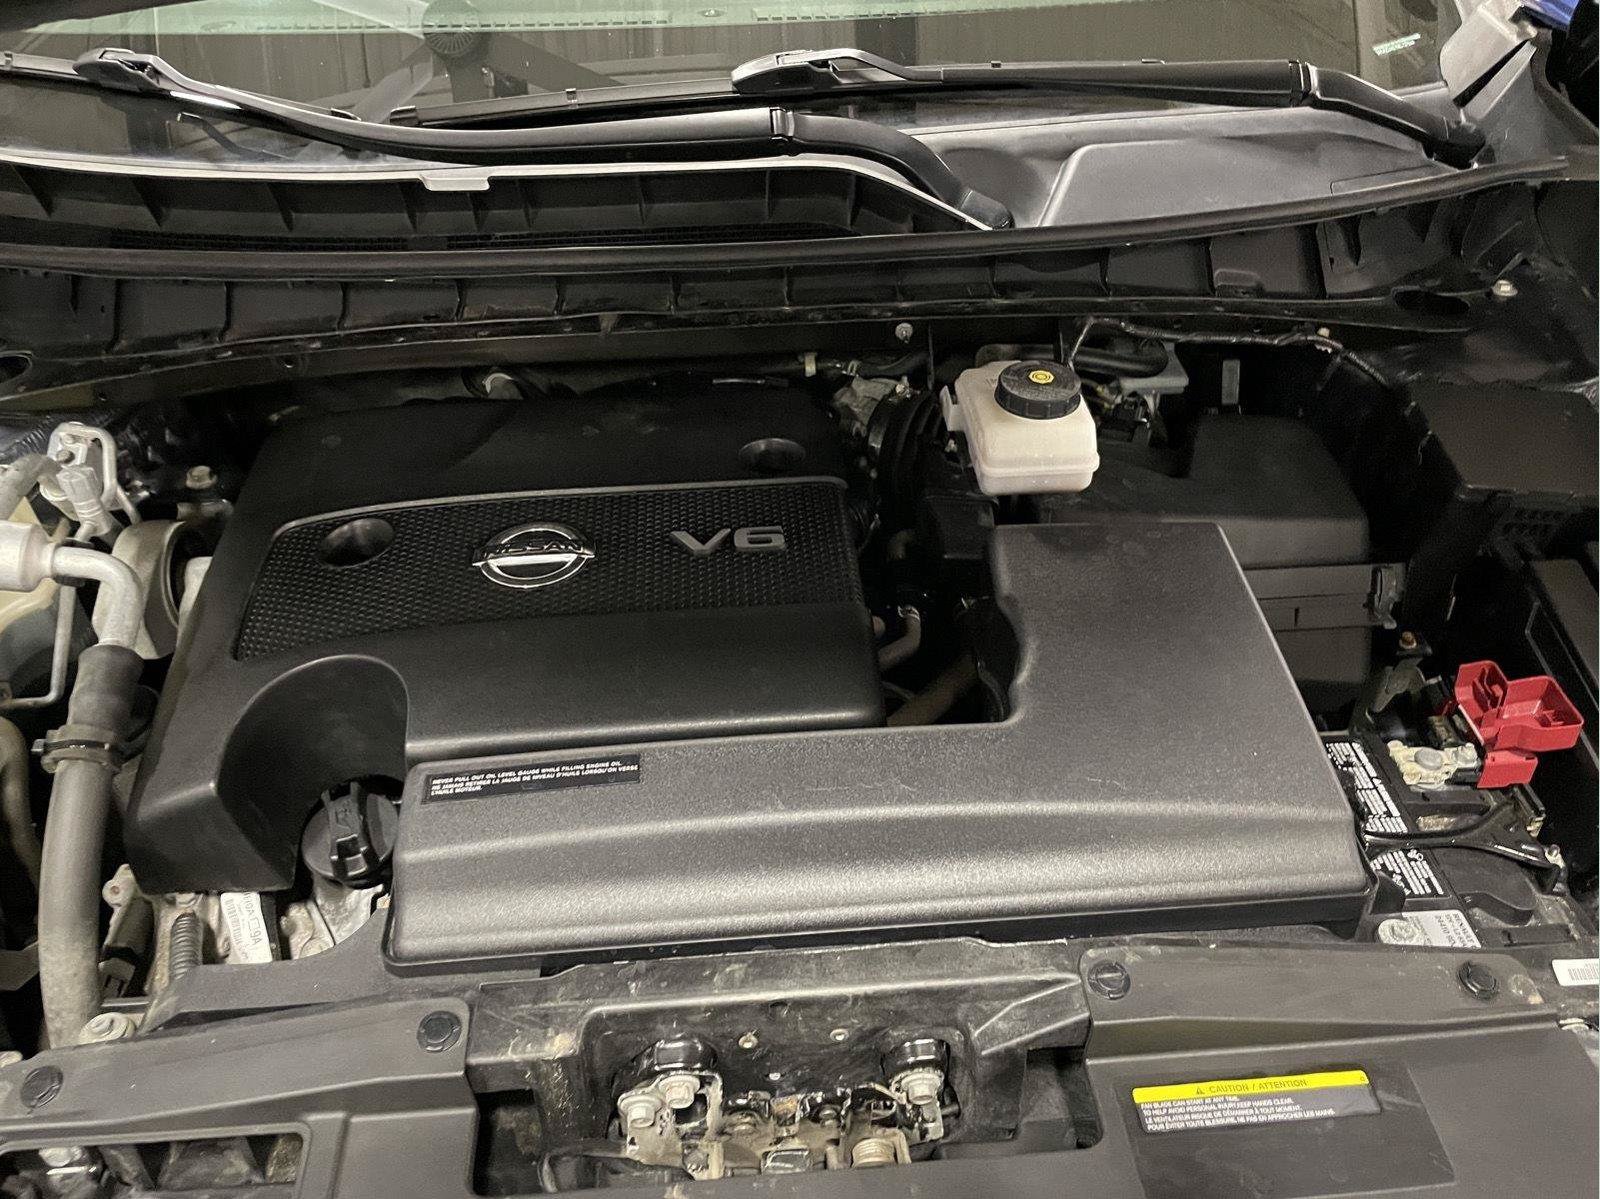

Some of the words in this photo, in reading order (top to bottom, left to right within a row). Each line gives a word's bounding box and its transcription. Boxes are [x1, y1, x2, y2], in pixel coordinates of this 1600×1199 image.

[669, 526, 785, 555] V6
[482, 540, 593, 559] NISSAN
[433, 777, 454, 785] NEVER
[442, 782, 465, 790] JAMAIS
[465, 779, 491, 787] RETIRER
[532, 772, 555, 780] NIVEAU
[556, 770, 580, 778] D'HUILE
[618, 764, 638, 772] VERSE
[431, 788, 454, 796] L'HUILE
[1209, 1085, 1249, 1095] CAUTION
[1259, 1079, 1308, 1091] ATTENTION
[1141, 1102, 1153, 1110] FAN
[1153, 1100, 1172, 1109] BLADE
[1172, 1099, 1186, 1107] CAN
[1186, 1097, 1204, 1105] START
[1204, 1096, 1212, 1104] AT
[1212, 1095, 1225, 1103] ANY
[1143, 1109, 1152, 1117] TO
[1152, 1107, 1168, 1116] HELP
[1168, 1105, 1186, 1114] AVOID
[1186, 1102, 1218, 1112] PERSONAL
[1252, 1098, 1273, 1107] HANDS
[1147, 1123, 1165, 1132] POUR
[1186, 1118, 1205, 1128] TOUTE
[1246, 1114, 1258, 1122] PAS
[1153, 1113, 1191, 1123] VENTILATEUR
[1191, 1111, 1213, 1120] RISQUE
[1213, 1110, 1222, 1118] DE
